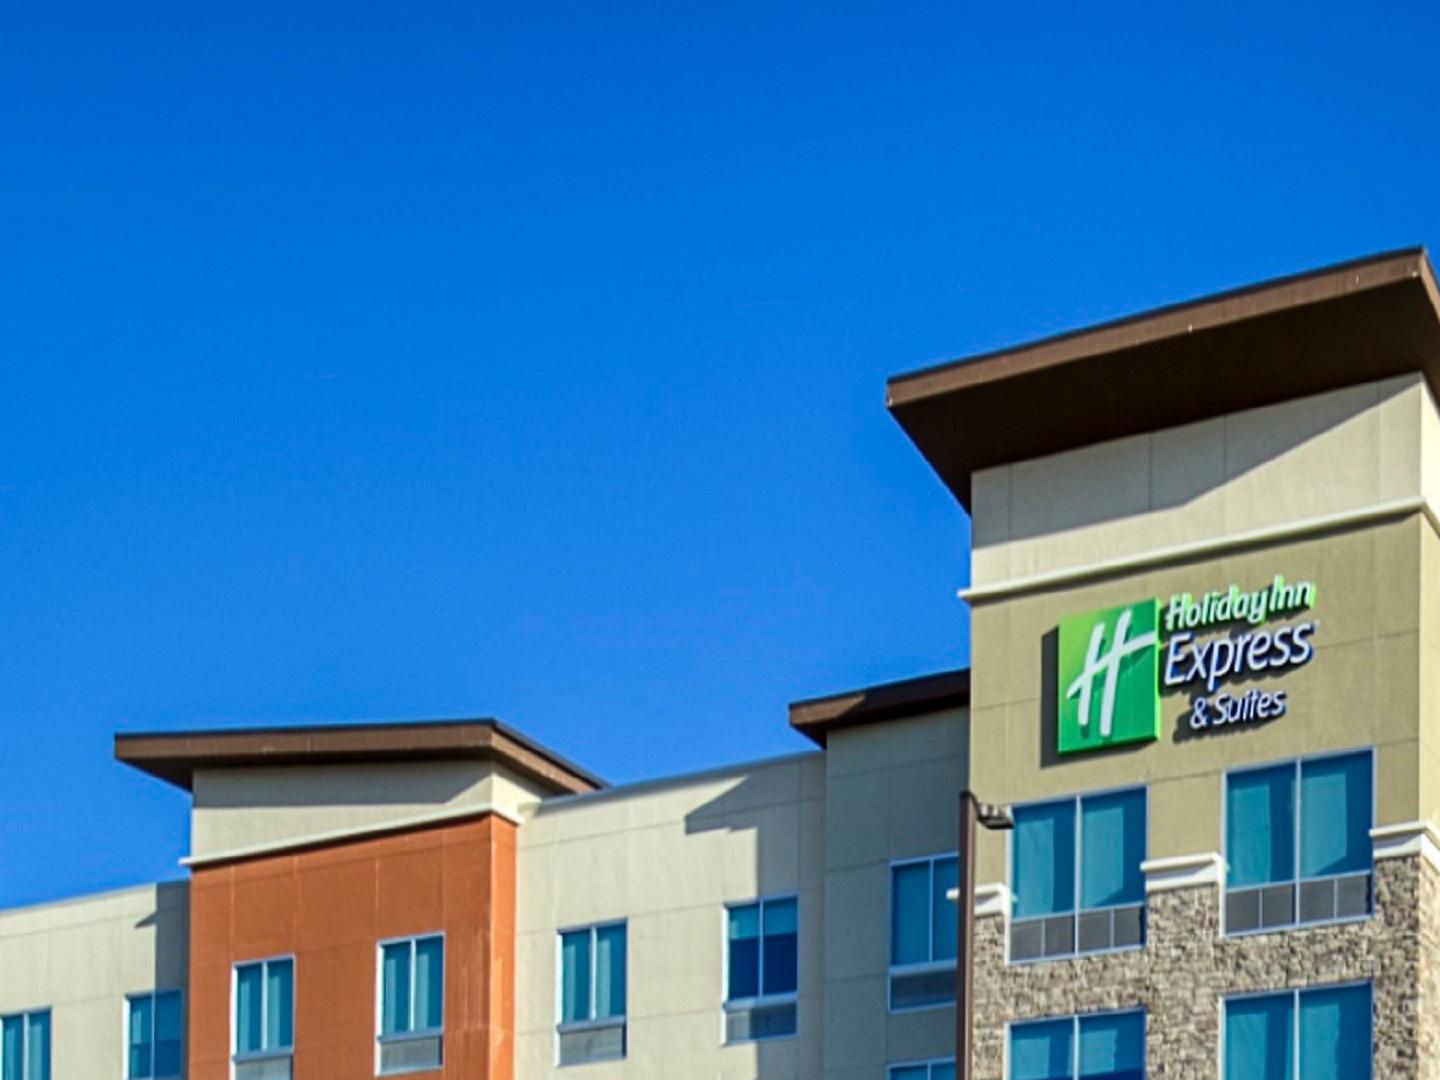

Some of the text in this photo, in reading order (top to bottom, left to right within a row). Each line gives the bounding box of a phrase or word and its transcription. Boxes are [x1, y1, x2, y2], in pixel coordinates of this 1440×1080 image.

[1166, 575, 1314, 631] Holiday Inn
[1165, 623, 1313, 691] Express
[1190, 689, 1286, 728] & Suites
